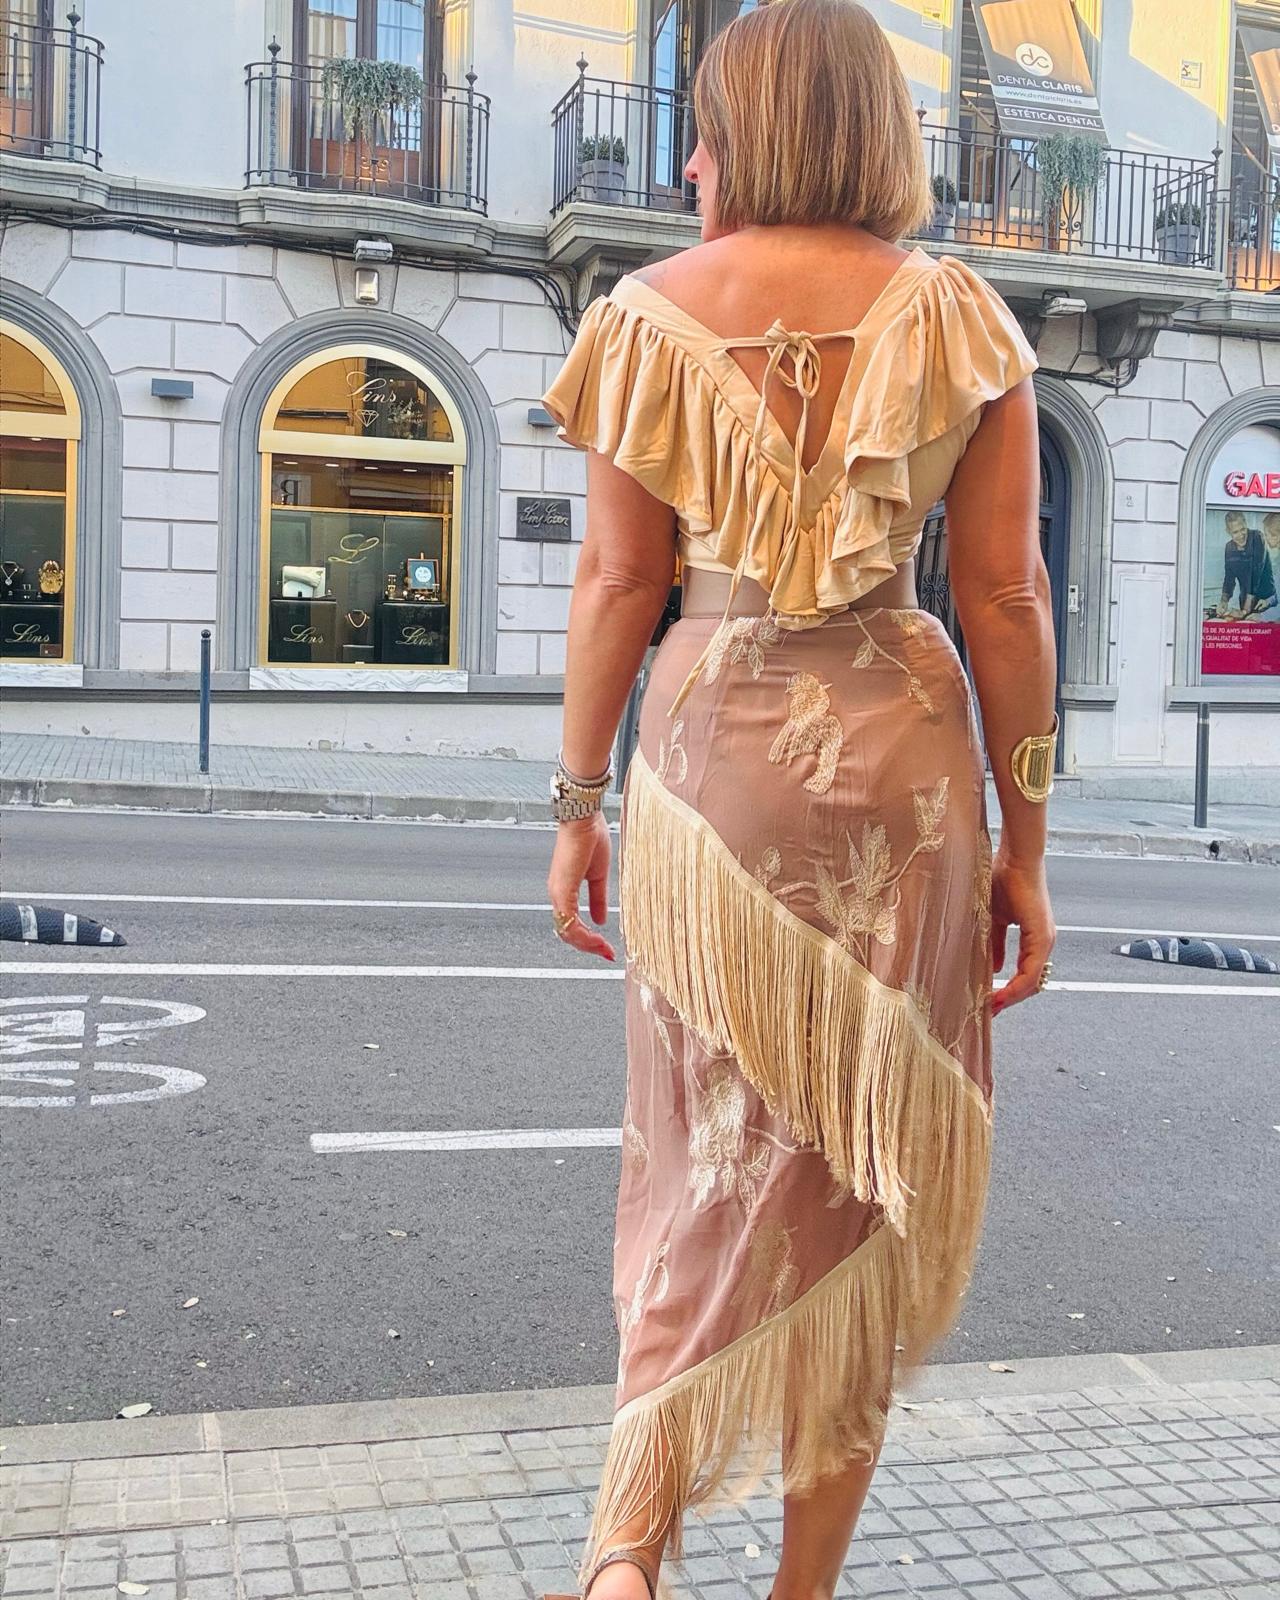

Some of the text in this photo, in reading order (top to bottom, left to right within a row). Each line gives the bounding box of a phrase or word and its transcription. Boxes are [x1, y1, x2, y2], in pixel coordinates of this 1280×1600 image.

[997, 75, 1083, 94] DENTAL CLARIS
[1003, 107, 1100, 127] ESTÉTICA DENTAL
[5, 623, 50, 643] Lins
[283, 624, 324, 644] Lins
[395, 626, 433, 646] Lins
